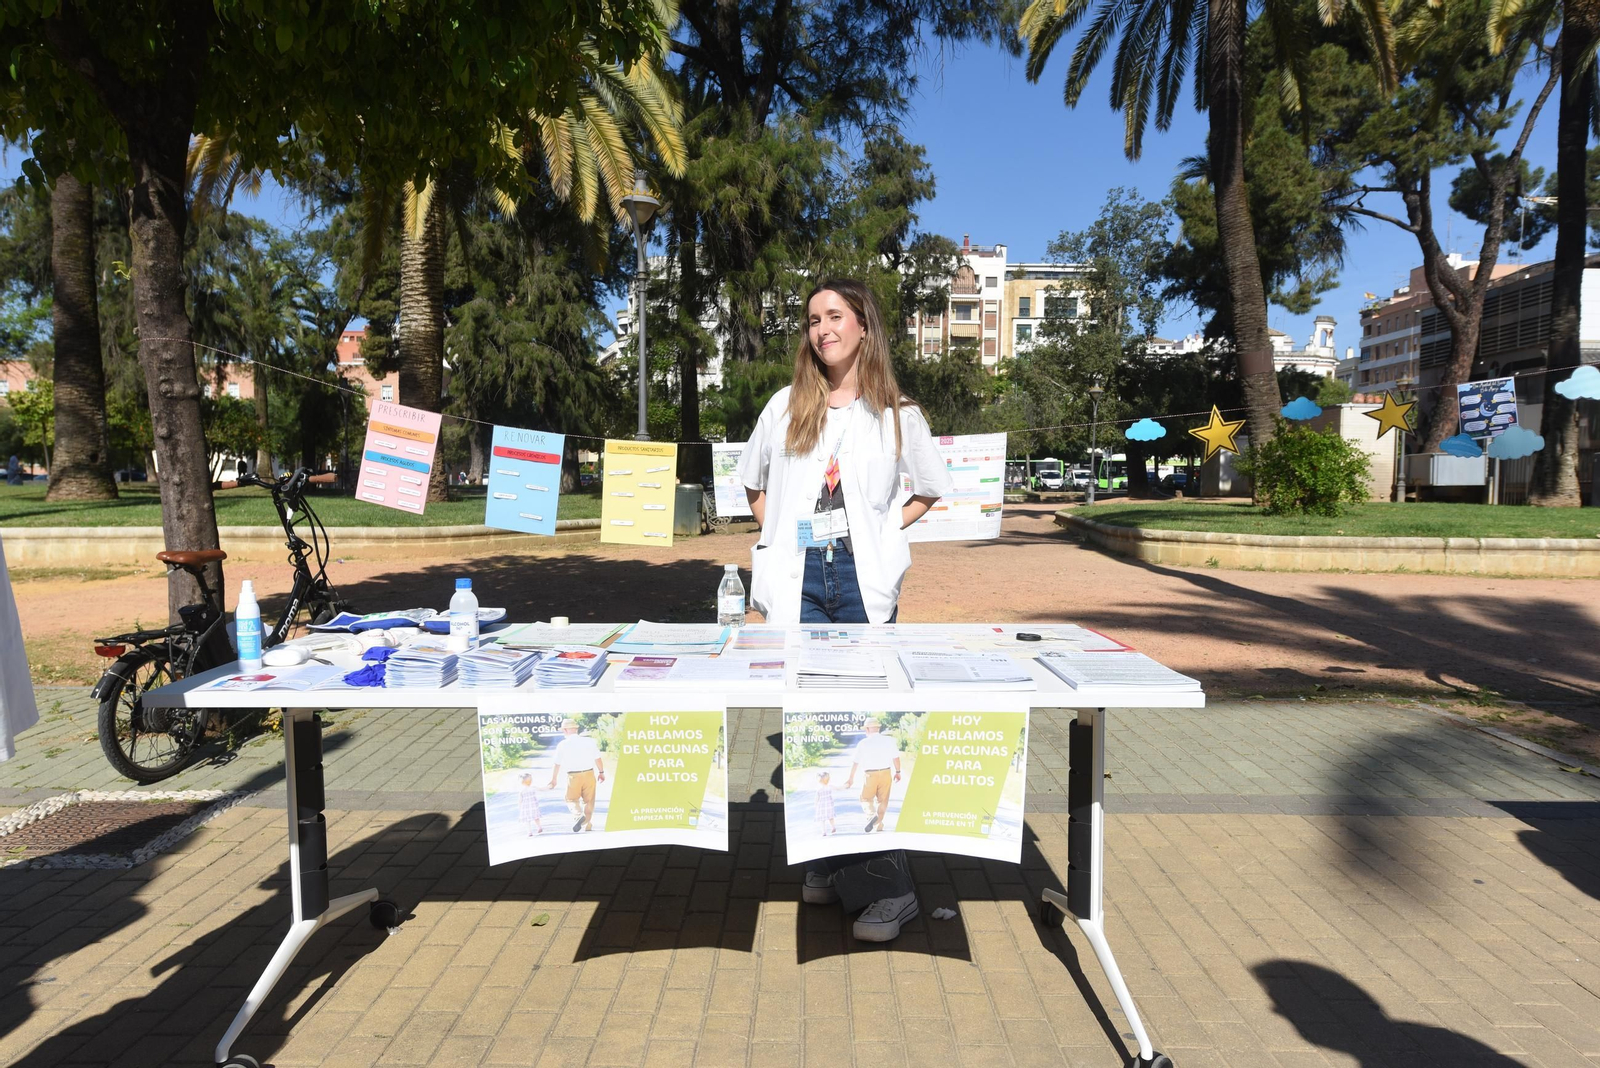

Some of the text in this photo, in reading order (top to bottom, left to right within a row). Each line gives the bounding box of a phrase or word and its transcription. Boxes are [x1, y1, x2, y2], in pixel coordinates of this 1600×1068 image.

[378, 404, 426, 422] PRESCRIBIR
[504, 430, 546, 445] RENOVAR
[278, 598, 298, 638] moma
[650, 715, 678, 725] HOY
[952, 715, 981, 726] HOY
[627, 730, 703, 740] HABLAMOS
[800, 734, 830, 742] NIÑOS
[928, 730, 1004, 741] HABLAMOS
[499, 736, 528, 745] NIÑOS
[623, 744, 709, 754] DE VACUNAS
[922, 745, 1008, 757] DE VACUNAS
[649, 759, 684, 768] PARA
[946, 760, 982, 770] PARA
[637, 772, 698, 782] ADULTOS
[932, 775, 994, 786] ADULTOS
[933, 812, 977, 820] PREVENCIÓN
